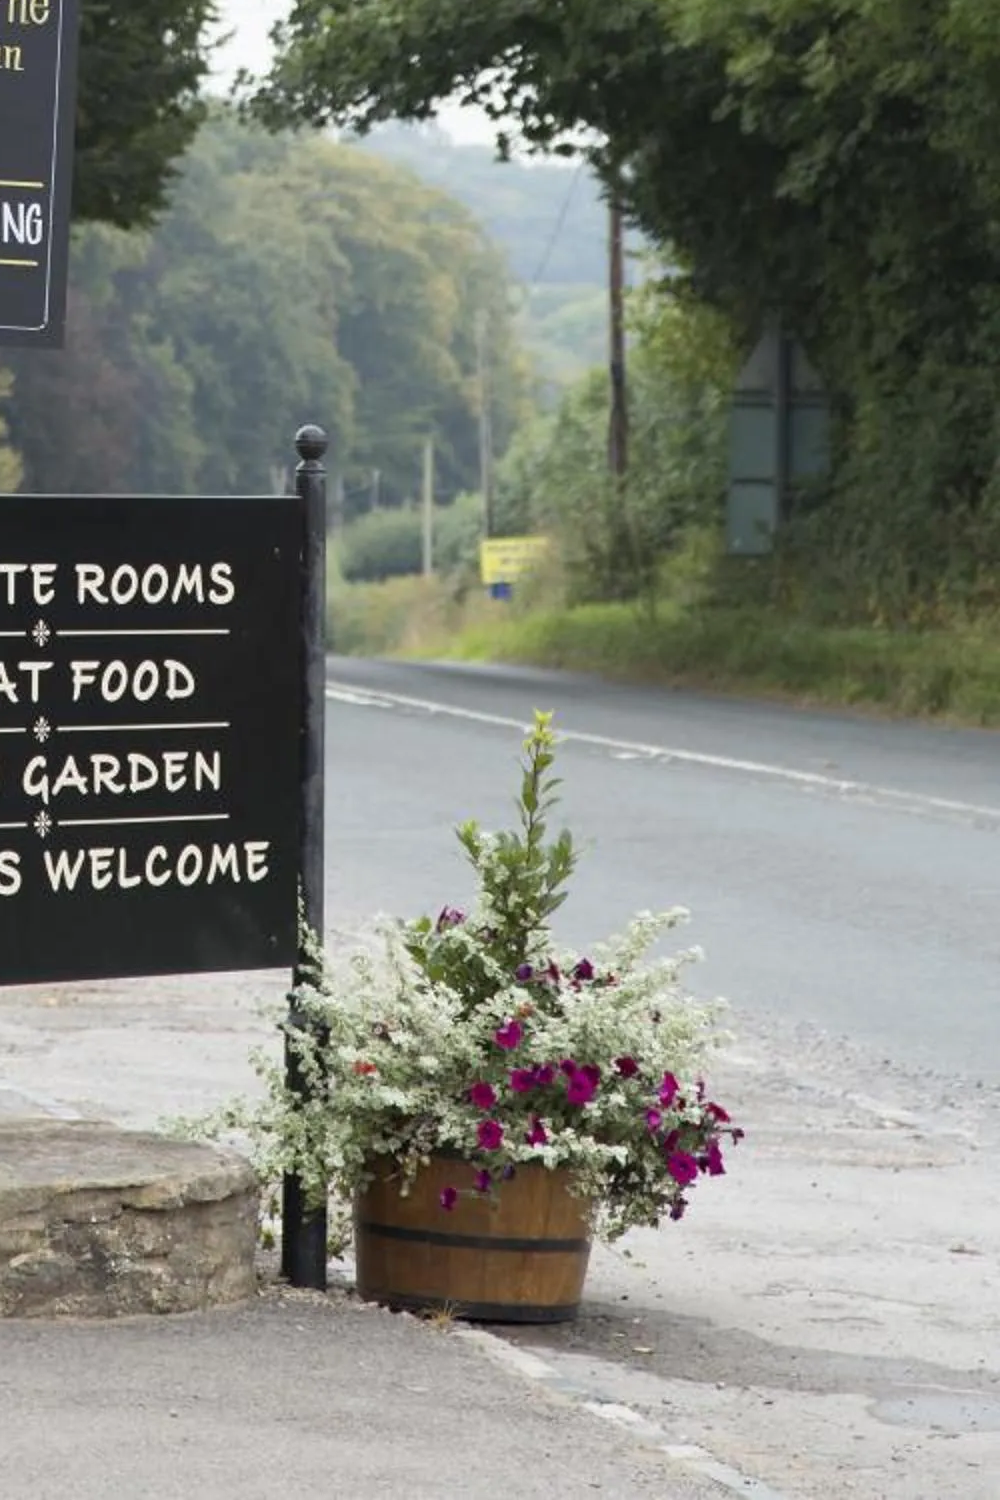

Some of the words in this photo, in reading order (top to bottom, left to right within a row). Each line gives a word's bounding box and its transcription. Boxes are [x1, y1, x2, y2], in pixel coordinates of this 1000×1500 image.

[75, 562, 235, 605] ROOMS
[70, 659, 196, 701] FOOD
[22, 751, 222, 805] GARDEN
[43, 841, 271, 893] WELCOME
